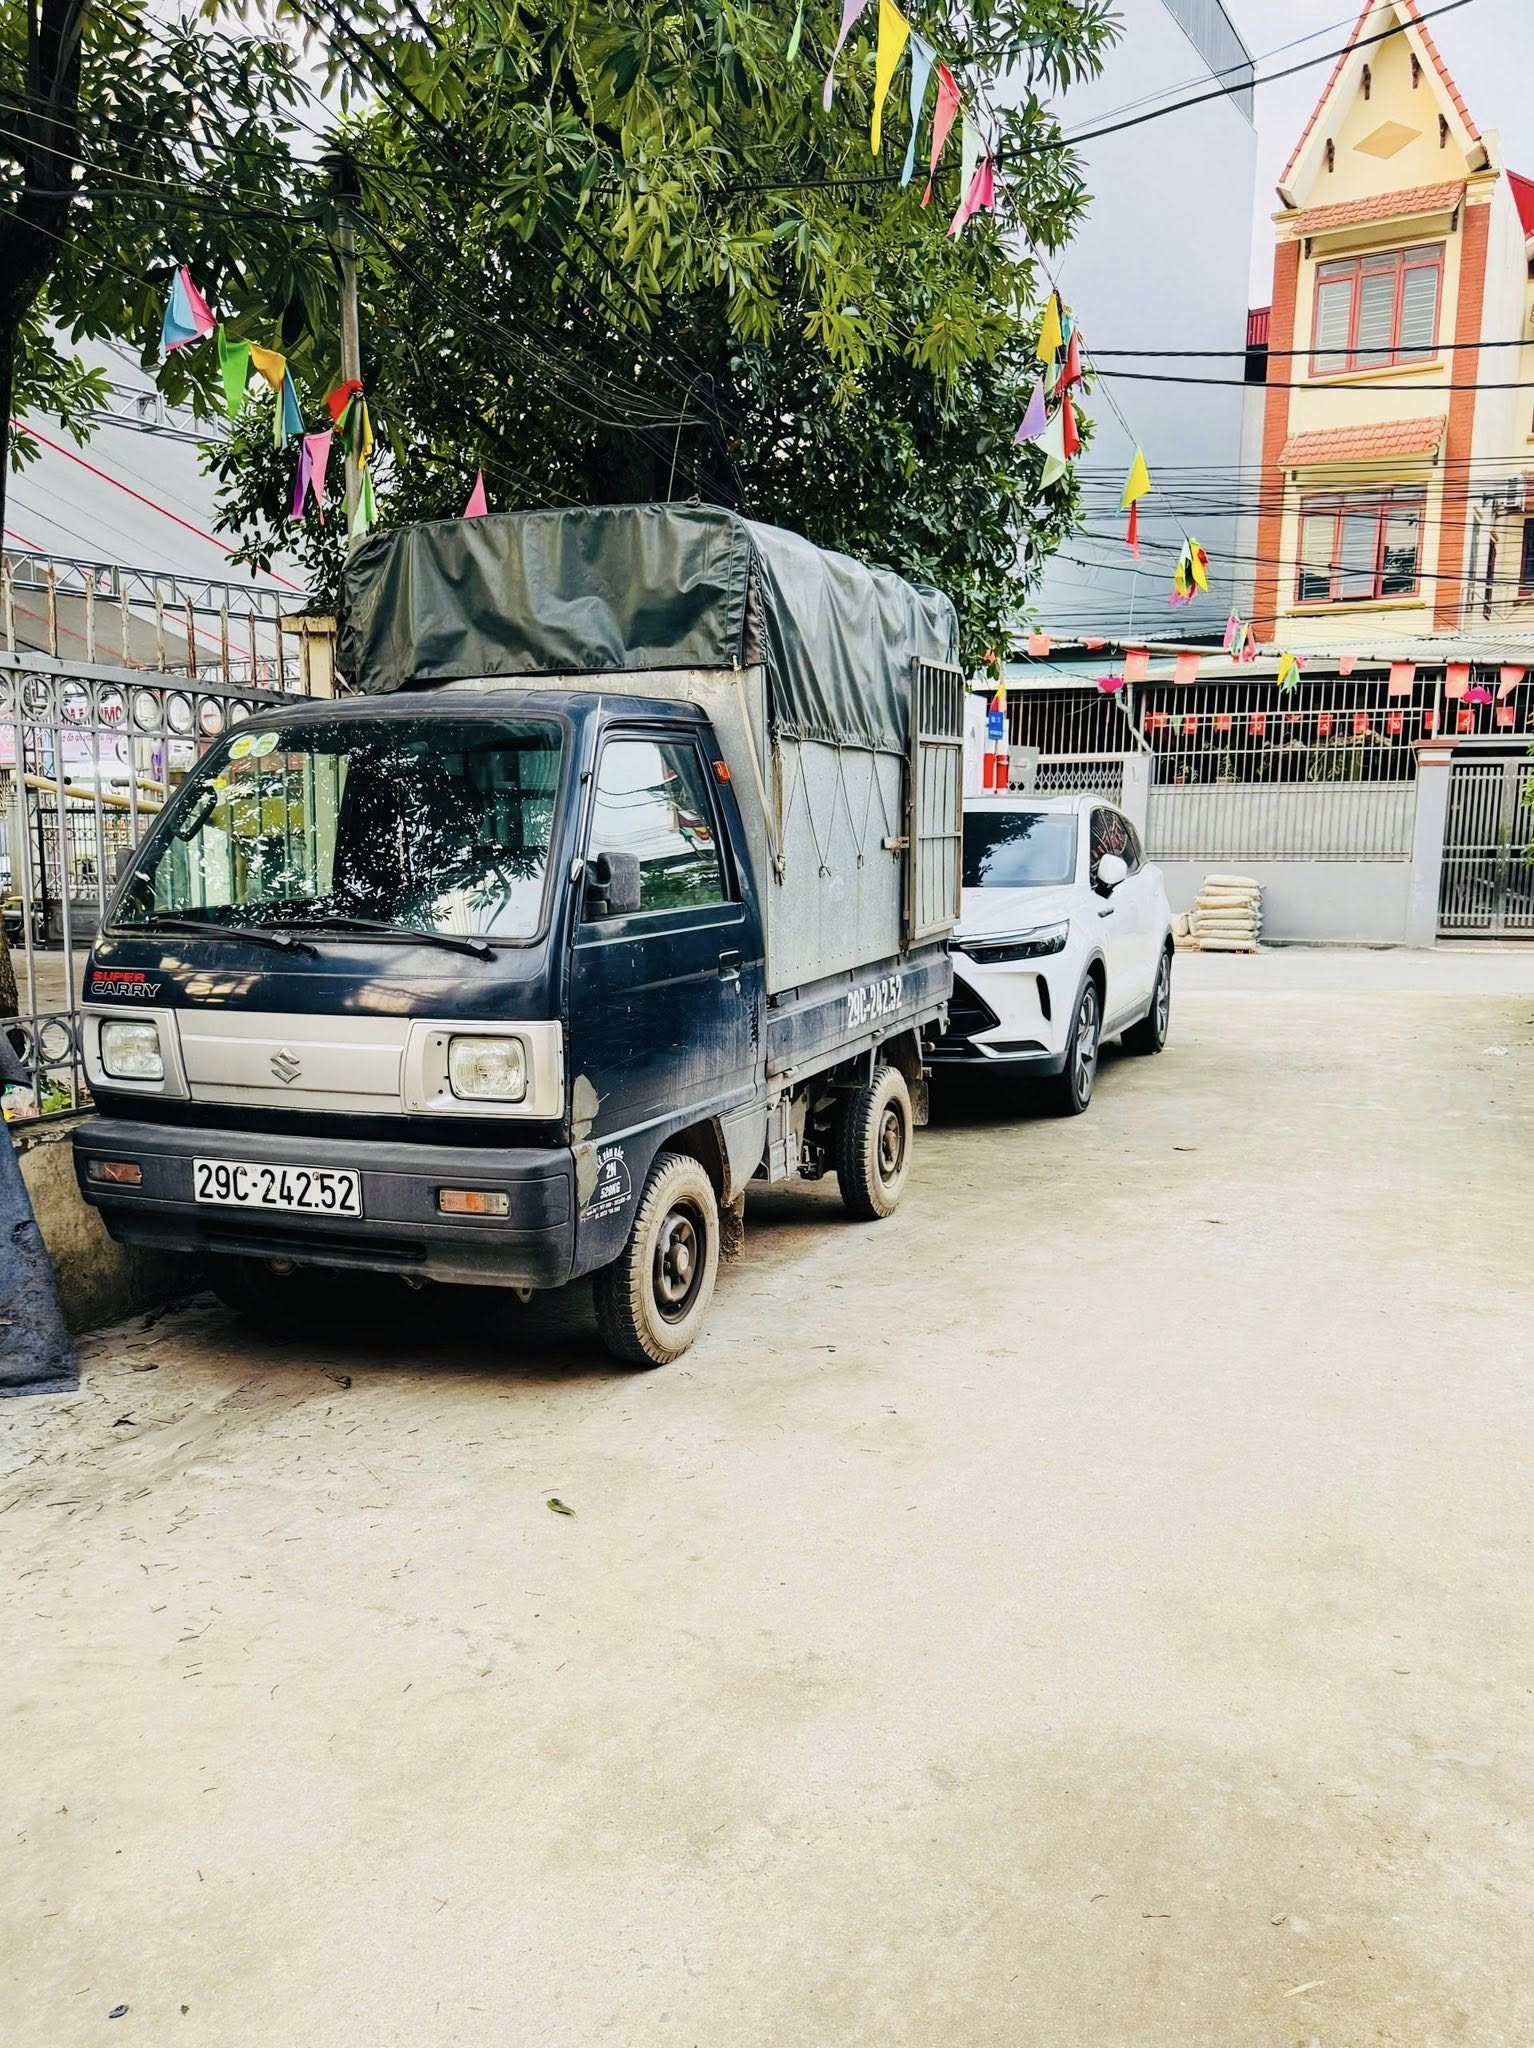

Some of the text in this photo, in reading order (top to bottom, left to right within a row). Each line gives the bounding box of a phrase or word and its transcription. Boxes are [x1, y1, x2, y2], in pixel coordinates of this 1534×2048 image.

[91, 981, 161, 997] CARRY
[93, 971, 145, 982] SUPER
[847, 974, 902, 1029] 29C-242.52
[197, 1163, 356, 1211] 29C-242.52
